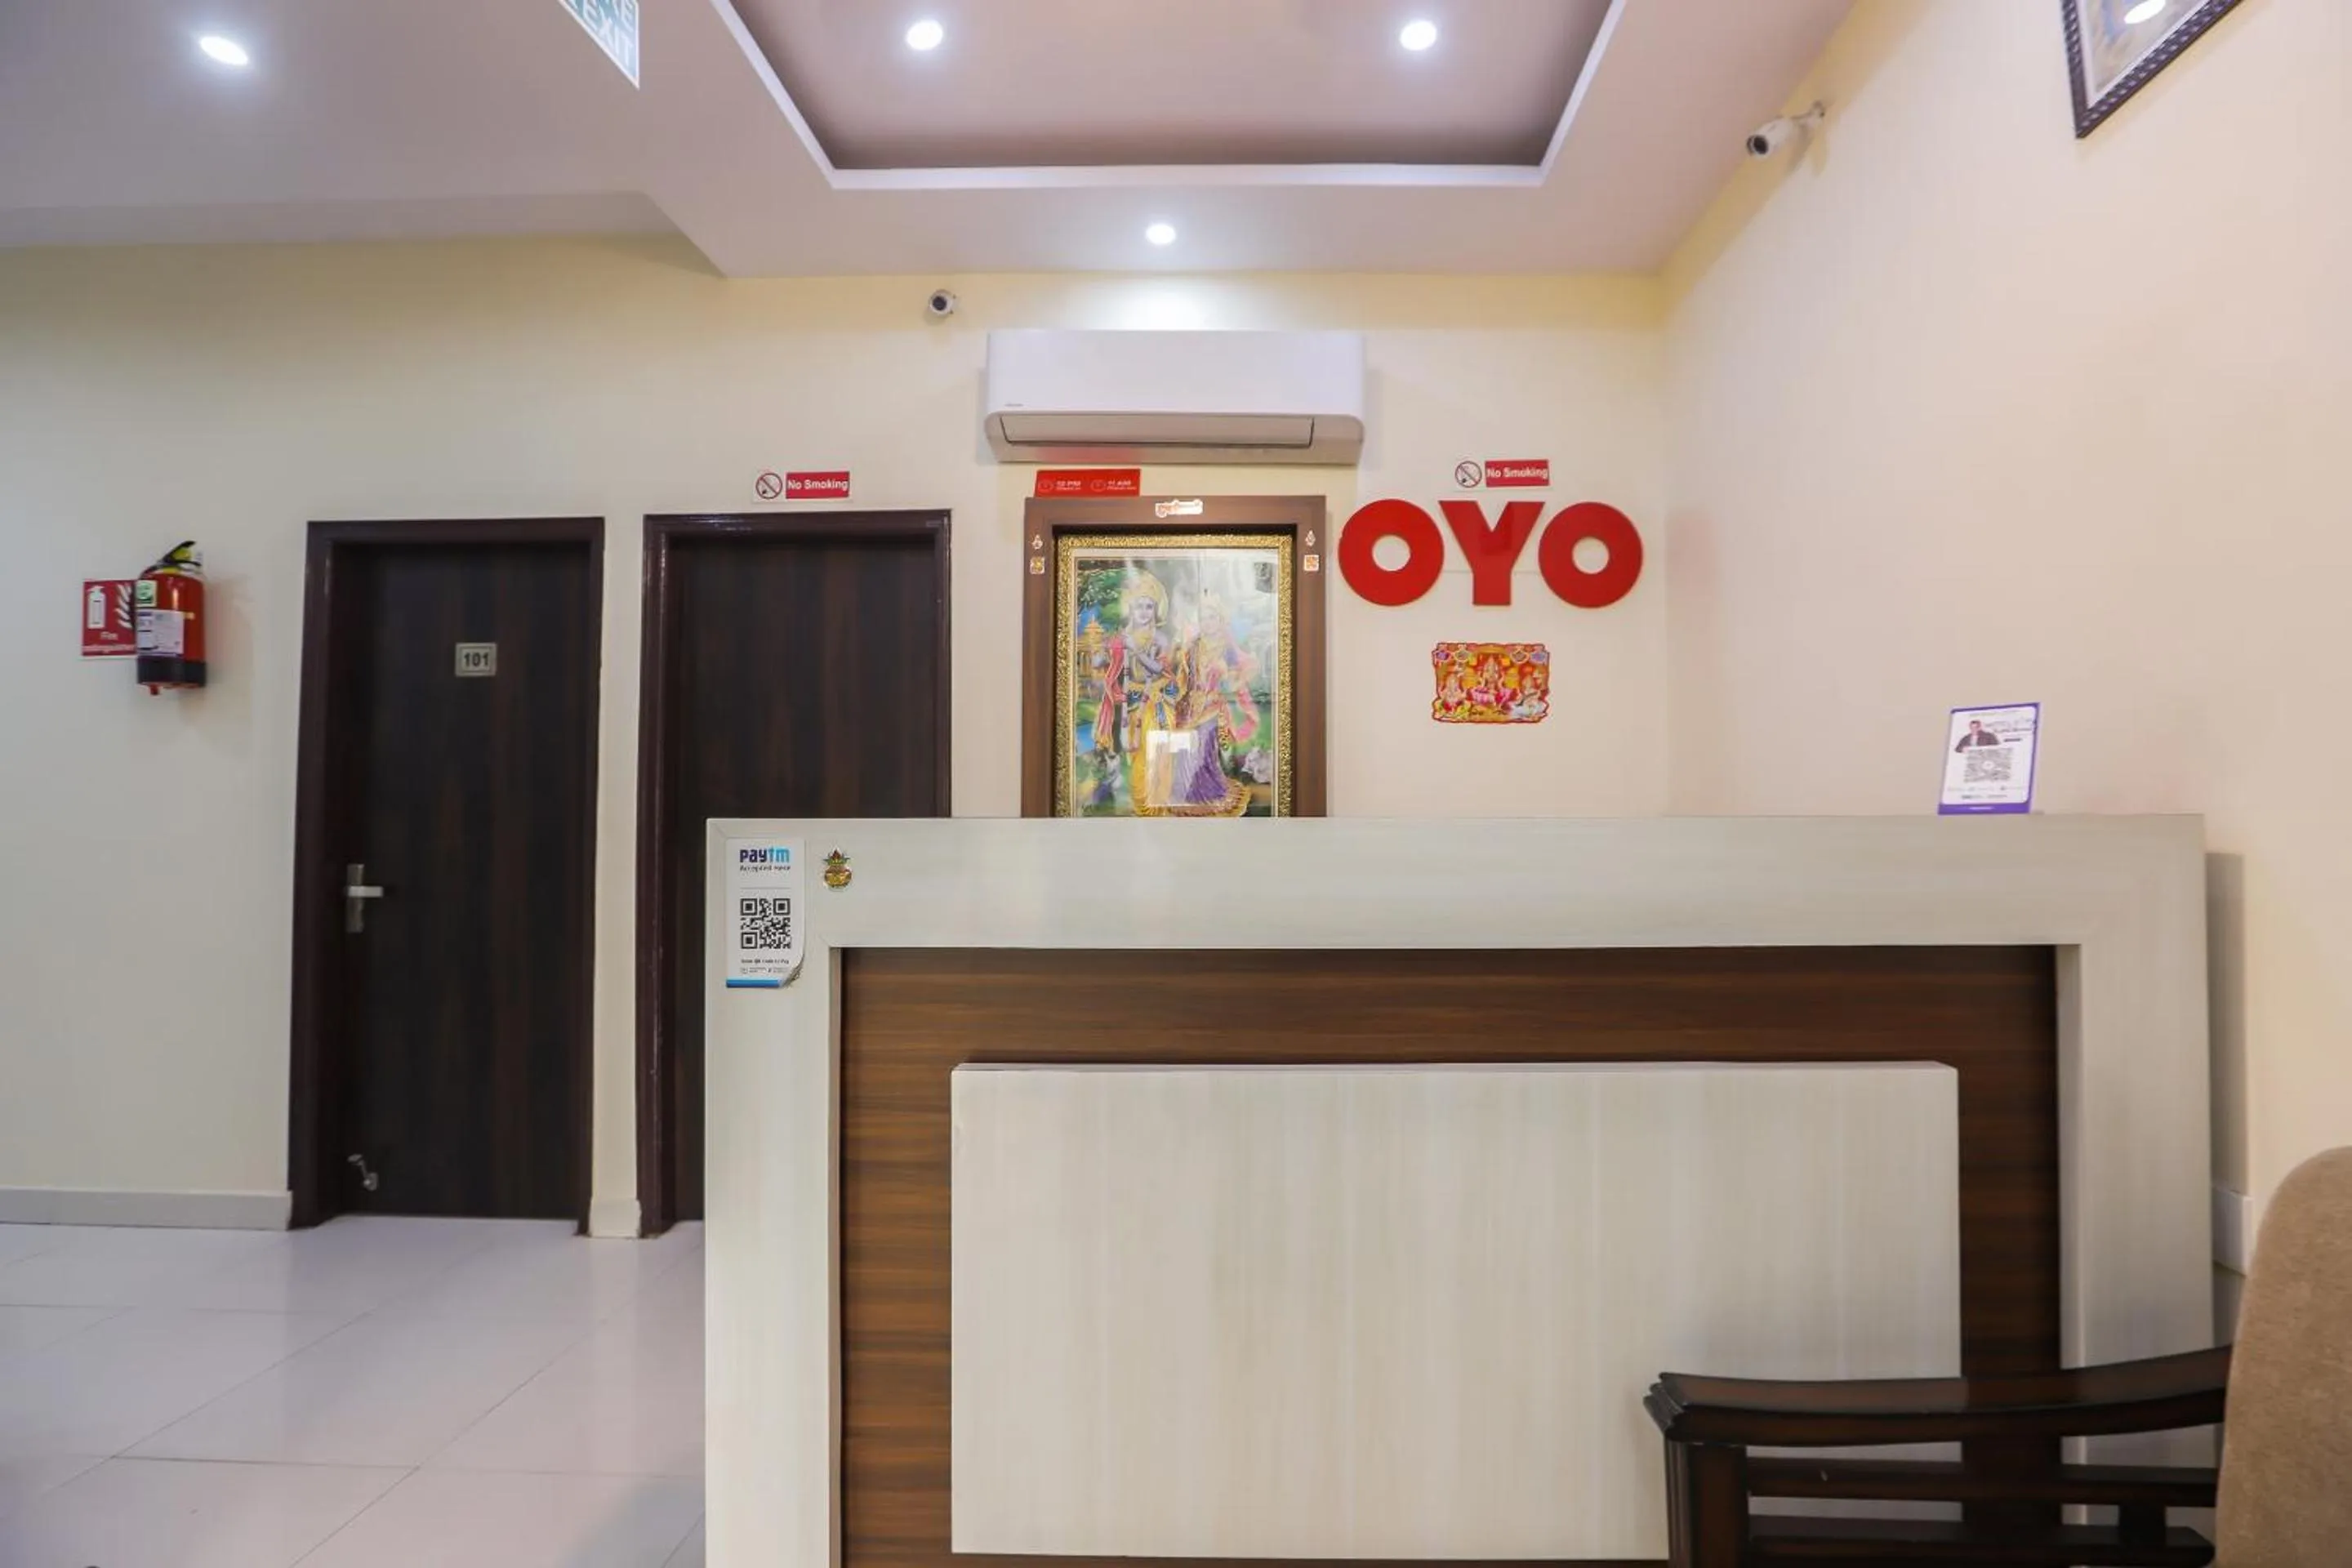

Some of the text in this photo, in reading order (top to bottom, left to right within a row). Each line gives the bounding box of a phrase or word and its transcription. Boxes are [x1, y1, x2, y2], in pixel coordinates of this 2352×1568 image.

[1487, 466, 1548, 479] No Smoking
[787, 479, 849, 492] No Smoking
[1338, 498, 1643, 608] OYO
[464, 653, 488, 667] 101
